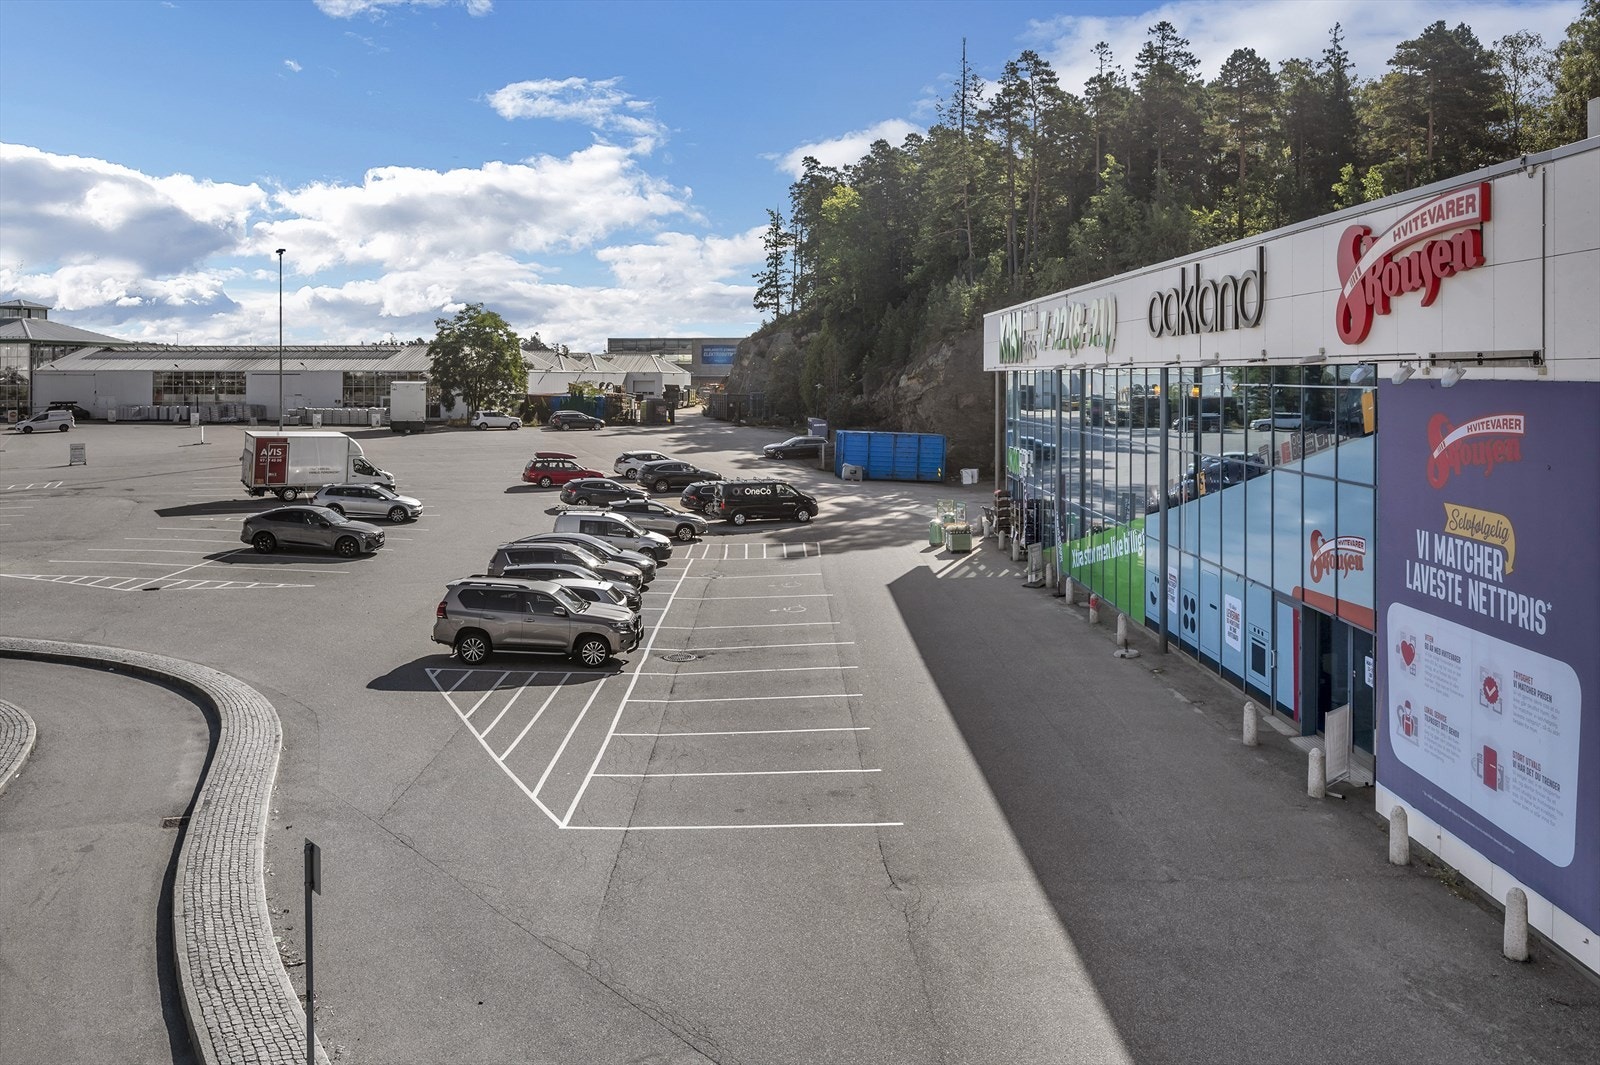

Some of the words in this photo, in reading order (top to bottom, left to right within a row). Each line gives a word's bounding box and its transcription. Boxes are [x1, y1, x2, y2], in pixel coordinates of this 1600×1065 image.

[1392, 193, 1477, 242] HVITEVARER
[1147, 246, 1266, 338] oakland
[1466, 418, 1522, 433] HVITEVARER
[260, 448, 282, 456] AVIS
[745, 487, 771, 496] OneCo
[1449, 508, 1510, 544] Selvfølgelig
[1071, 549, 1084, 569] Xtra
[1096, 542, 1111, 562] men
[1110, 536, 1123, 558] like
[1338, 539, 1364, 549] HVITEVARER
[1416, 529, 1430, 561] VI
[1434, 533, 1504, 583] MATCHER
[1406, 560, 1463, 606] LAVESTE
[1513, 679, 1518, 688] VI
[1517, 682, 1537, 697] MATCHER
[1537, 689, 1553, 703] PRISEN
[1512, 750, 1525, 764] STORT
[1525, 756, 1542, 772] UTVALG
[1512, 759, 1517, 769] VI
[1517, 761, 1526, 774] HAR
[1526, 766, 1534, 778] DET
[1534, 771, 1542, 782] DU
[1542, 774, 1561, 792] TRENGER
